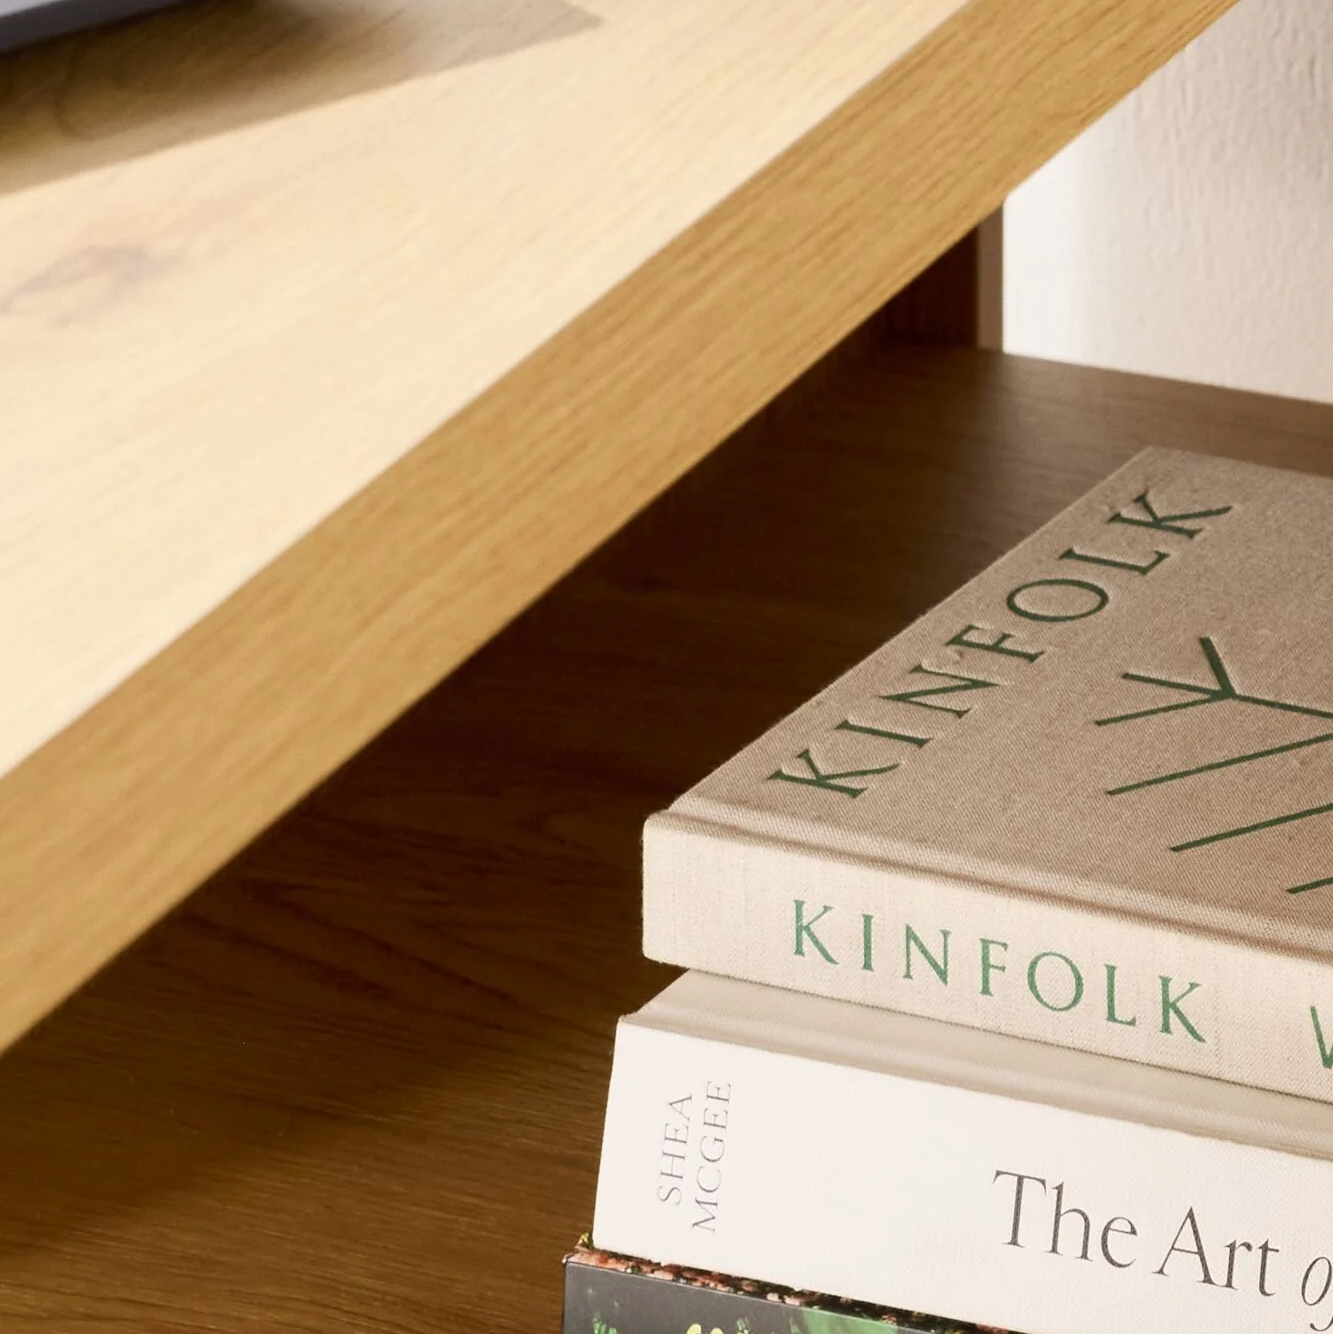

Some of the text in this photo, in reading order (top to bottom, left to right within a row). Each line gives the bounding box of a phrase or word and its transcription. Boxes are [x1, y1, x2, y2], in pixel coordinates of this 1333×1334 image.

[767, 490, 1232, 797] KINFOLK
[793, 899, 1207, 1042] KINFOLK
[657, 1094, 692, 1205] SHEA
[692, 1081, 731, 1232] MCGEE
[993, 1169, 1137, 1269] The
[1152, 1206, 1280, 1298] Art
